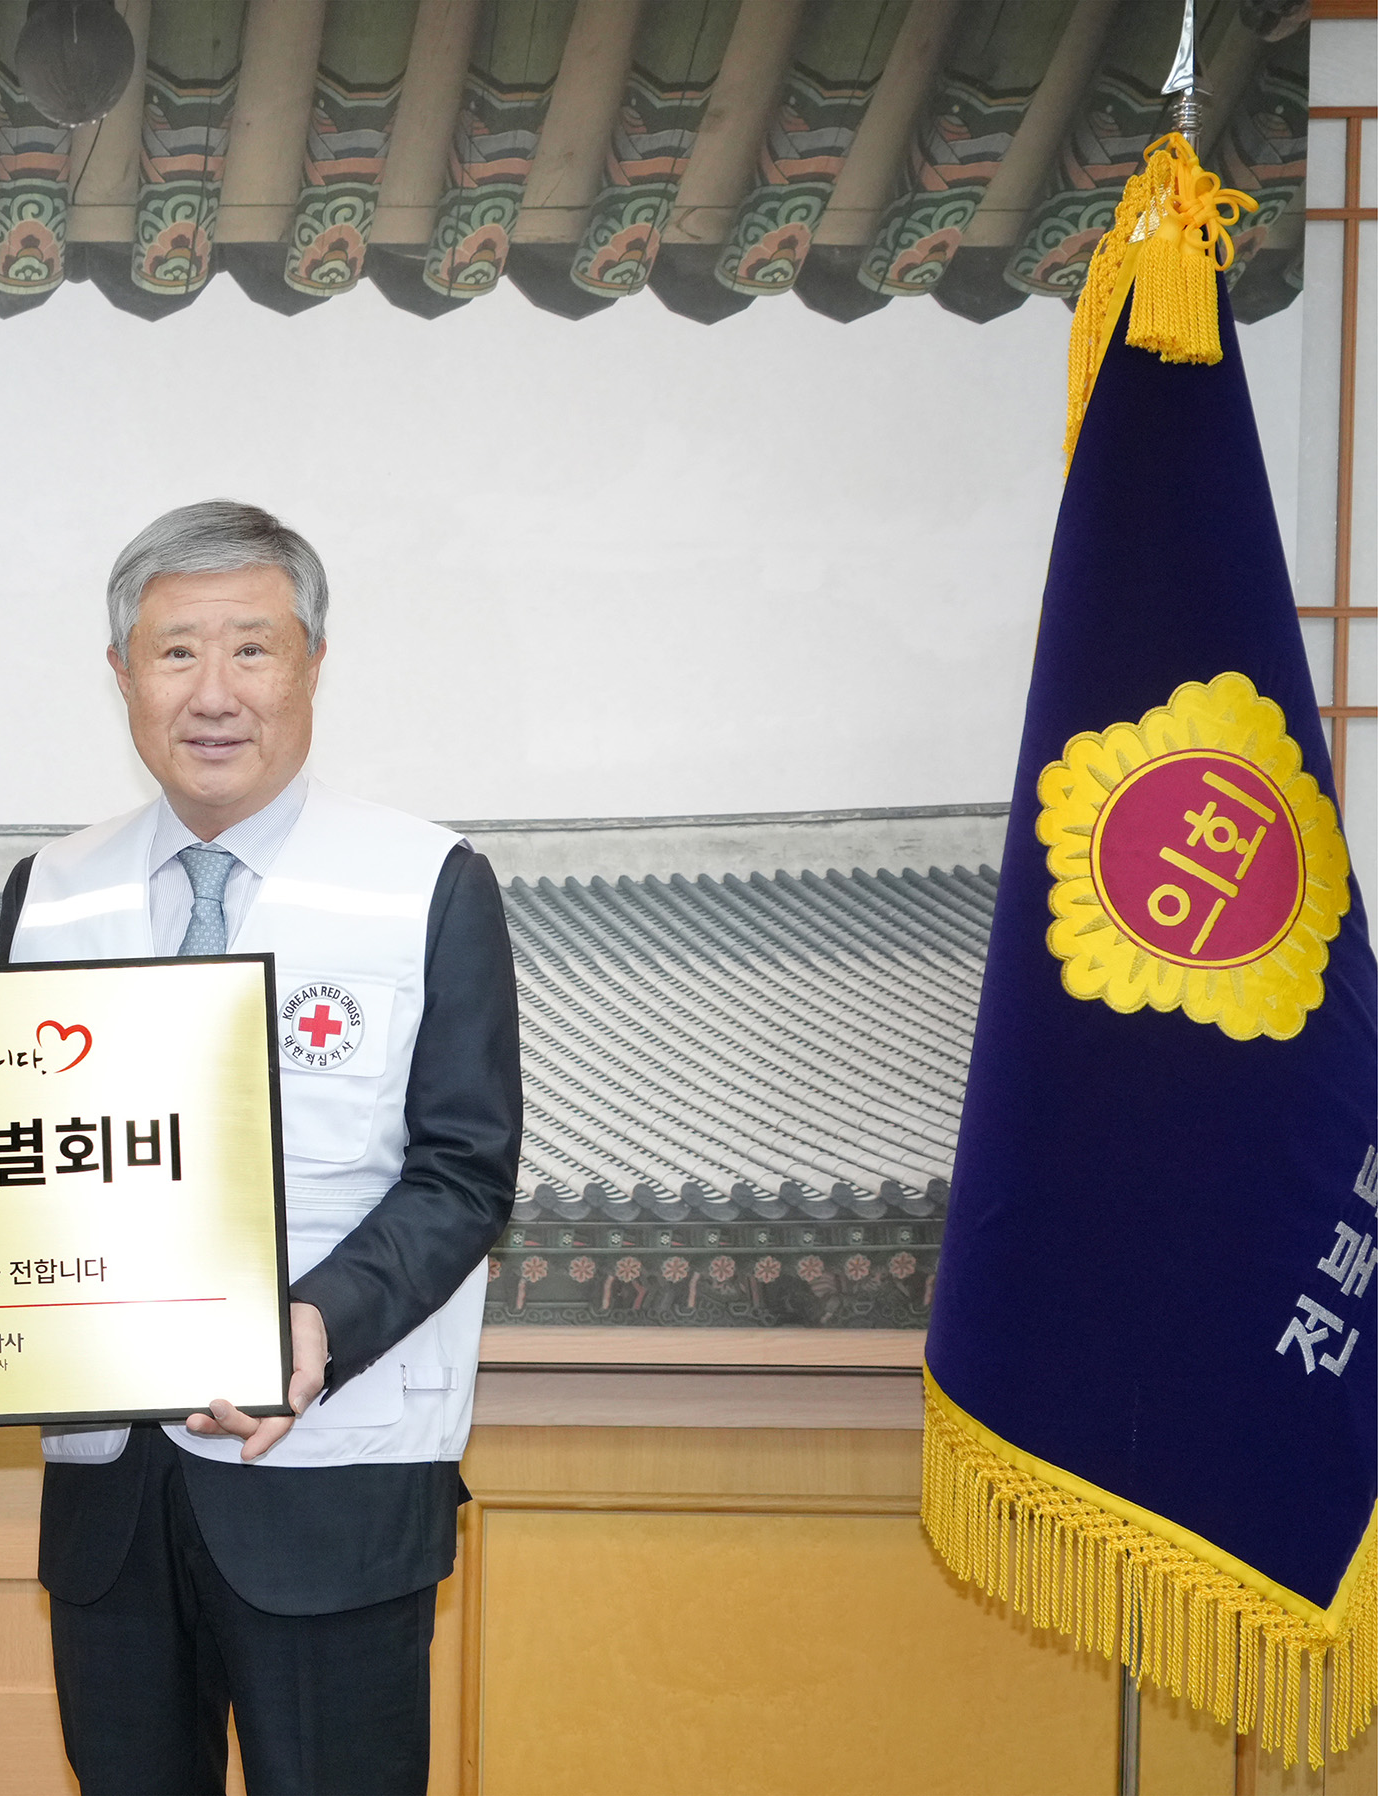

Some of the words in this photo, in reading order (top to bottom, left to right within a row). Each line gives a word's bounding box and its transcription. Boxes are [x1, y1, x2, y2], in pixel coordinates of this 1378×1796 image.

[1147, 771, 1277, 954] 의회
[282, 986, 318, 1021] KOREAN
[320, 985, 341, 1000] RED
[340, 995, 361, 1027] CROSS
[283, 1034, 354, 1067] 대한적십자사
[9, 1257, 108, 1285] 전합니다
